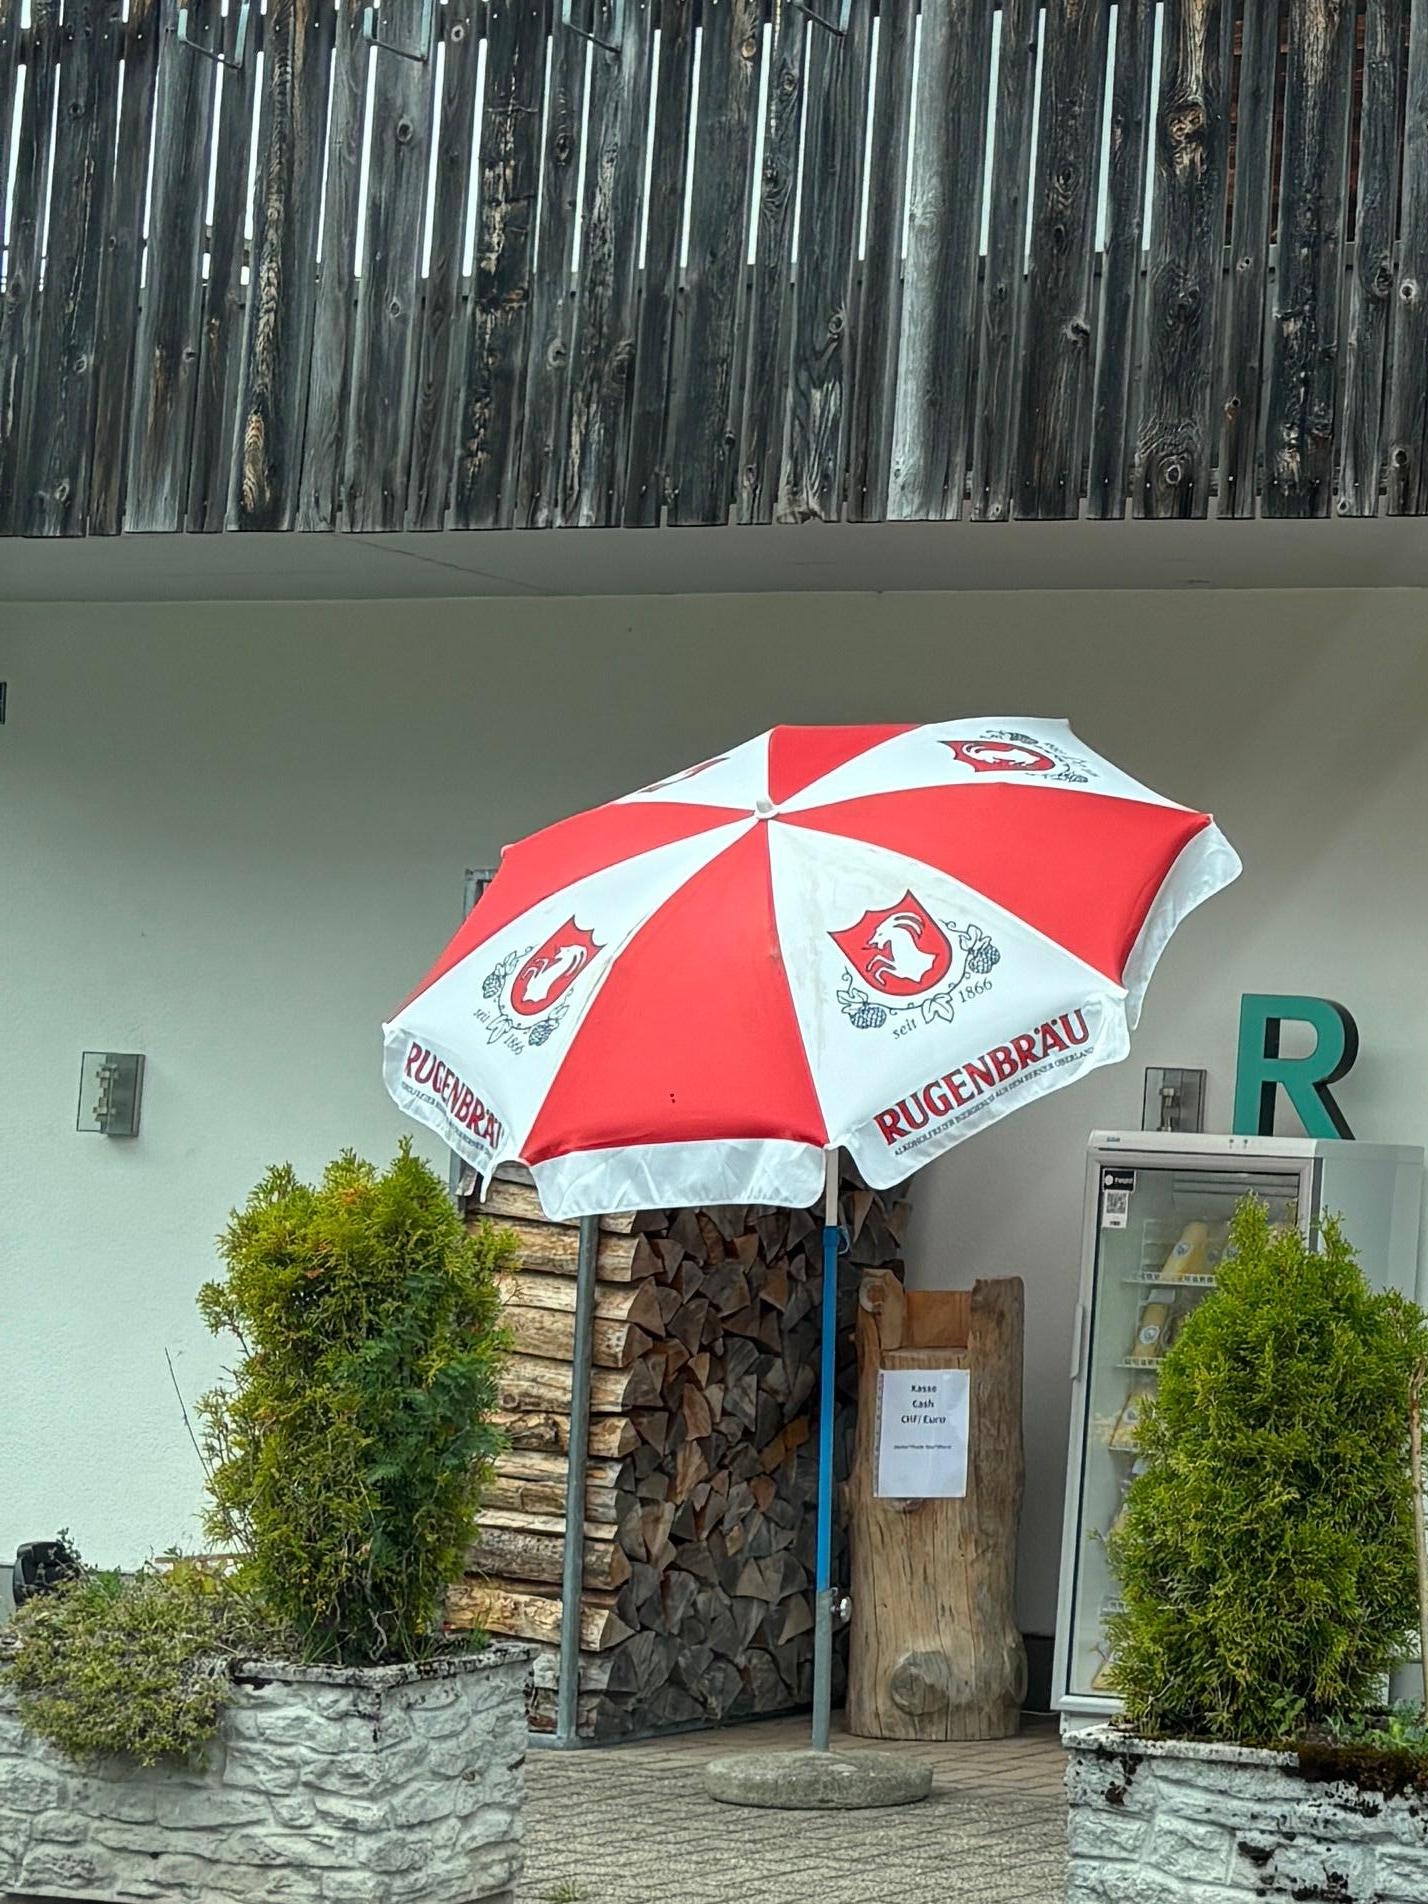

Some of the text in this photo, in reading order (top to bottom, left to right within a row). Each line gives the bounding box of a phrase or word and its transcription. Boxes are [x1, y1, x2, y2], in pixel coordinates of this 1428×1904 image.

[872, 1007, 1091, 1147] RUGENBRÄU
[892, 977, 994, 1040] seit 1866
[1232, 992, 1359, 1140] R
